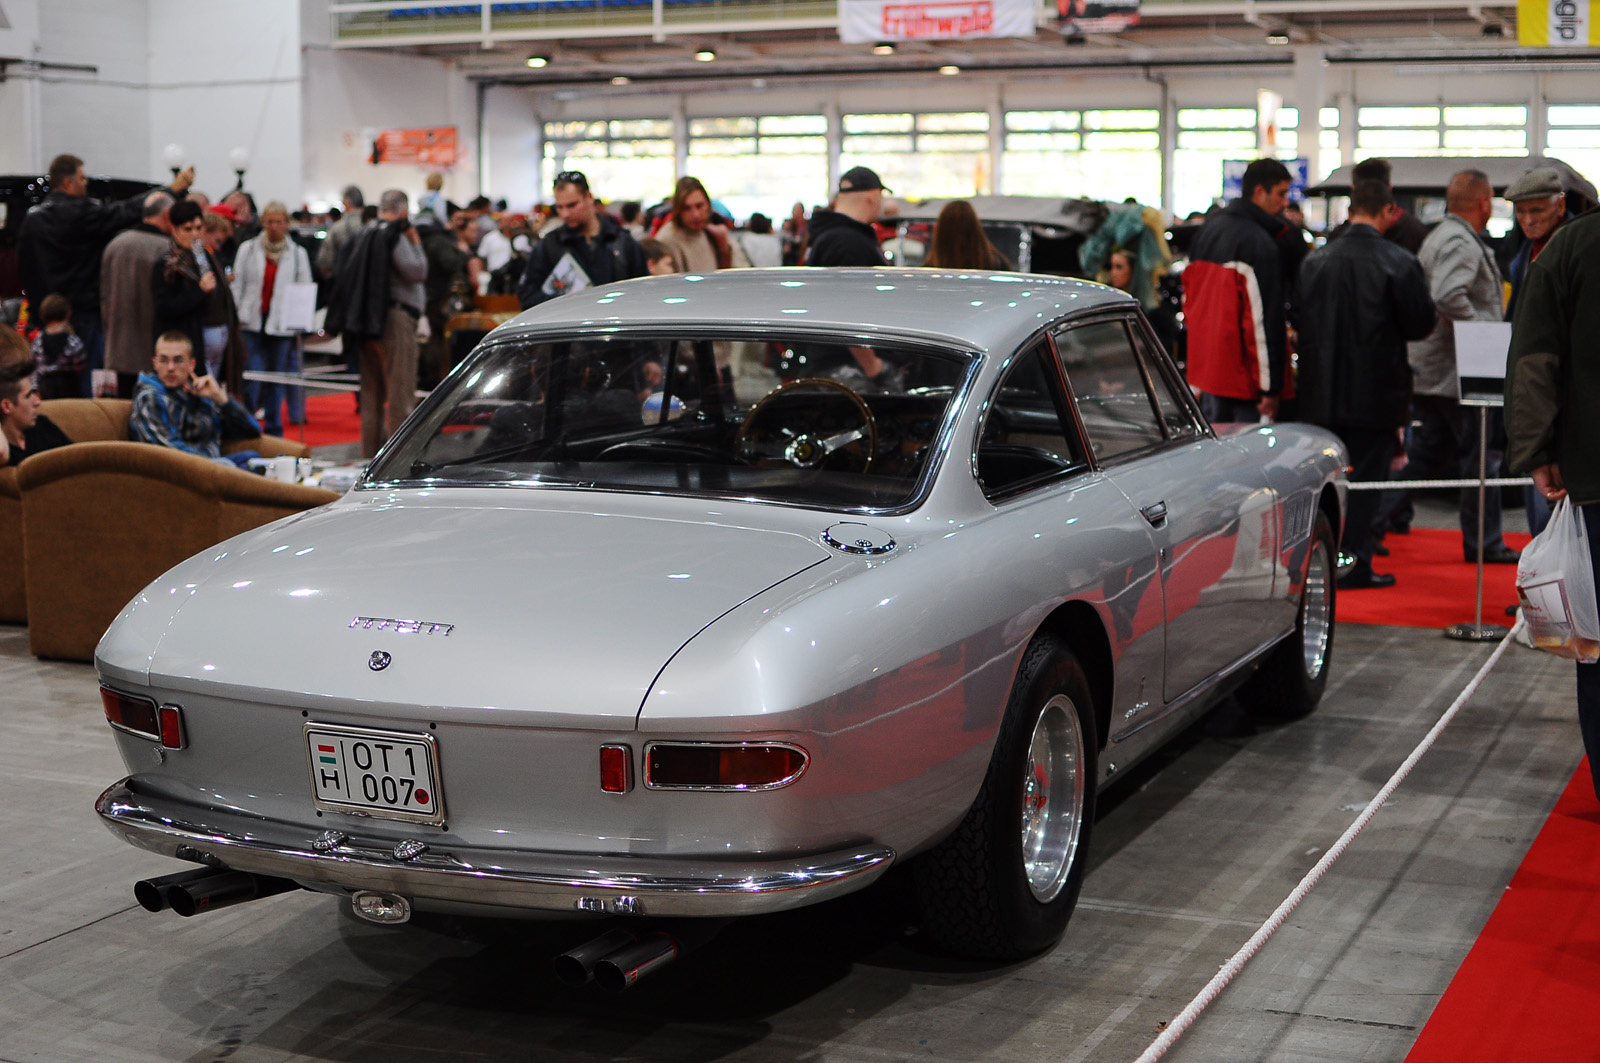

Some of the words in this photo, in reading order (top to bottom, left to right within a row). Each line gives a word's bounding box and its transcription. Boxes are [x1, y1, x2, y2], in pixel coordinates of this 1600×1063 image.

[883, 1, 993, 37] Frühwald
[1555, 0, 1578, 39] gip
[352, 741, 394, 773] OT
[404, 747, 416, 776] 1
[320, 768, 341, 790] H
[362, 773, 416, 806] 007
